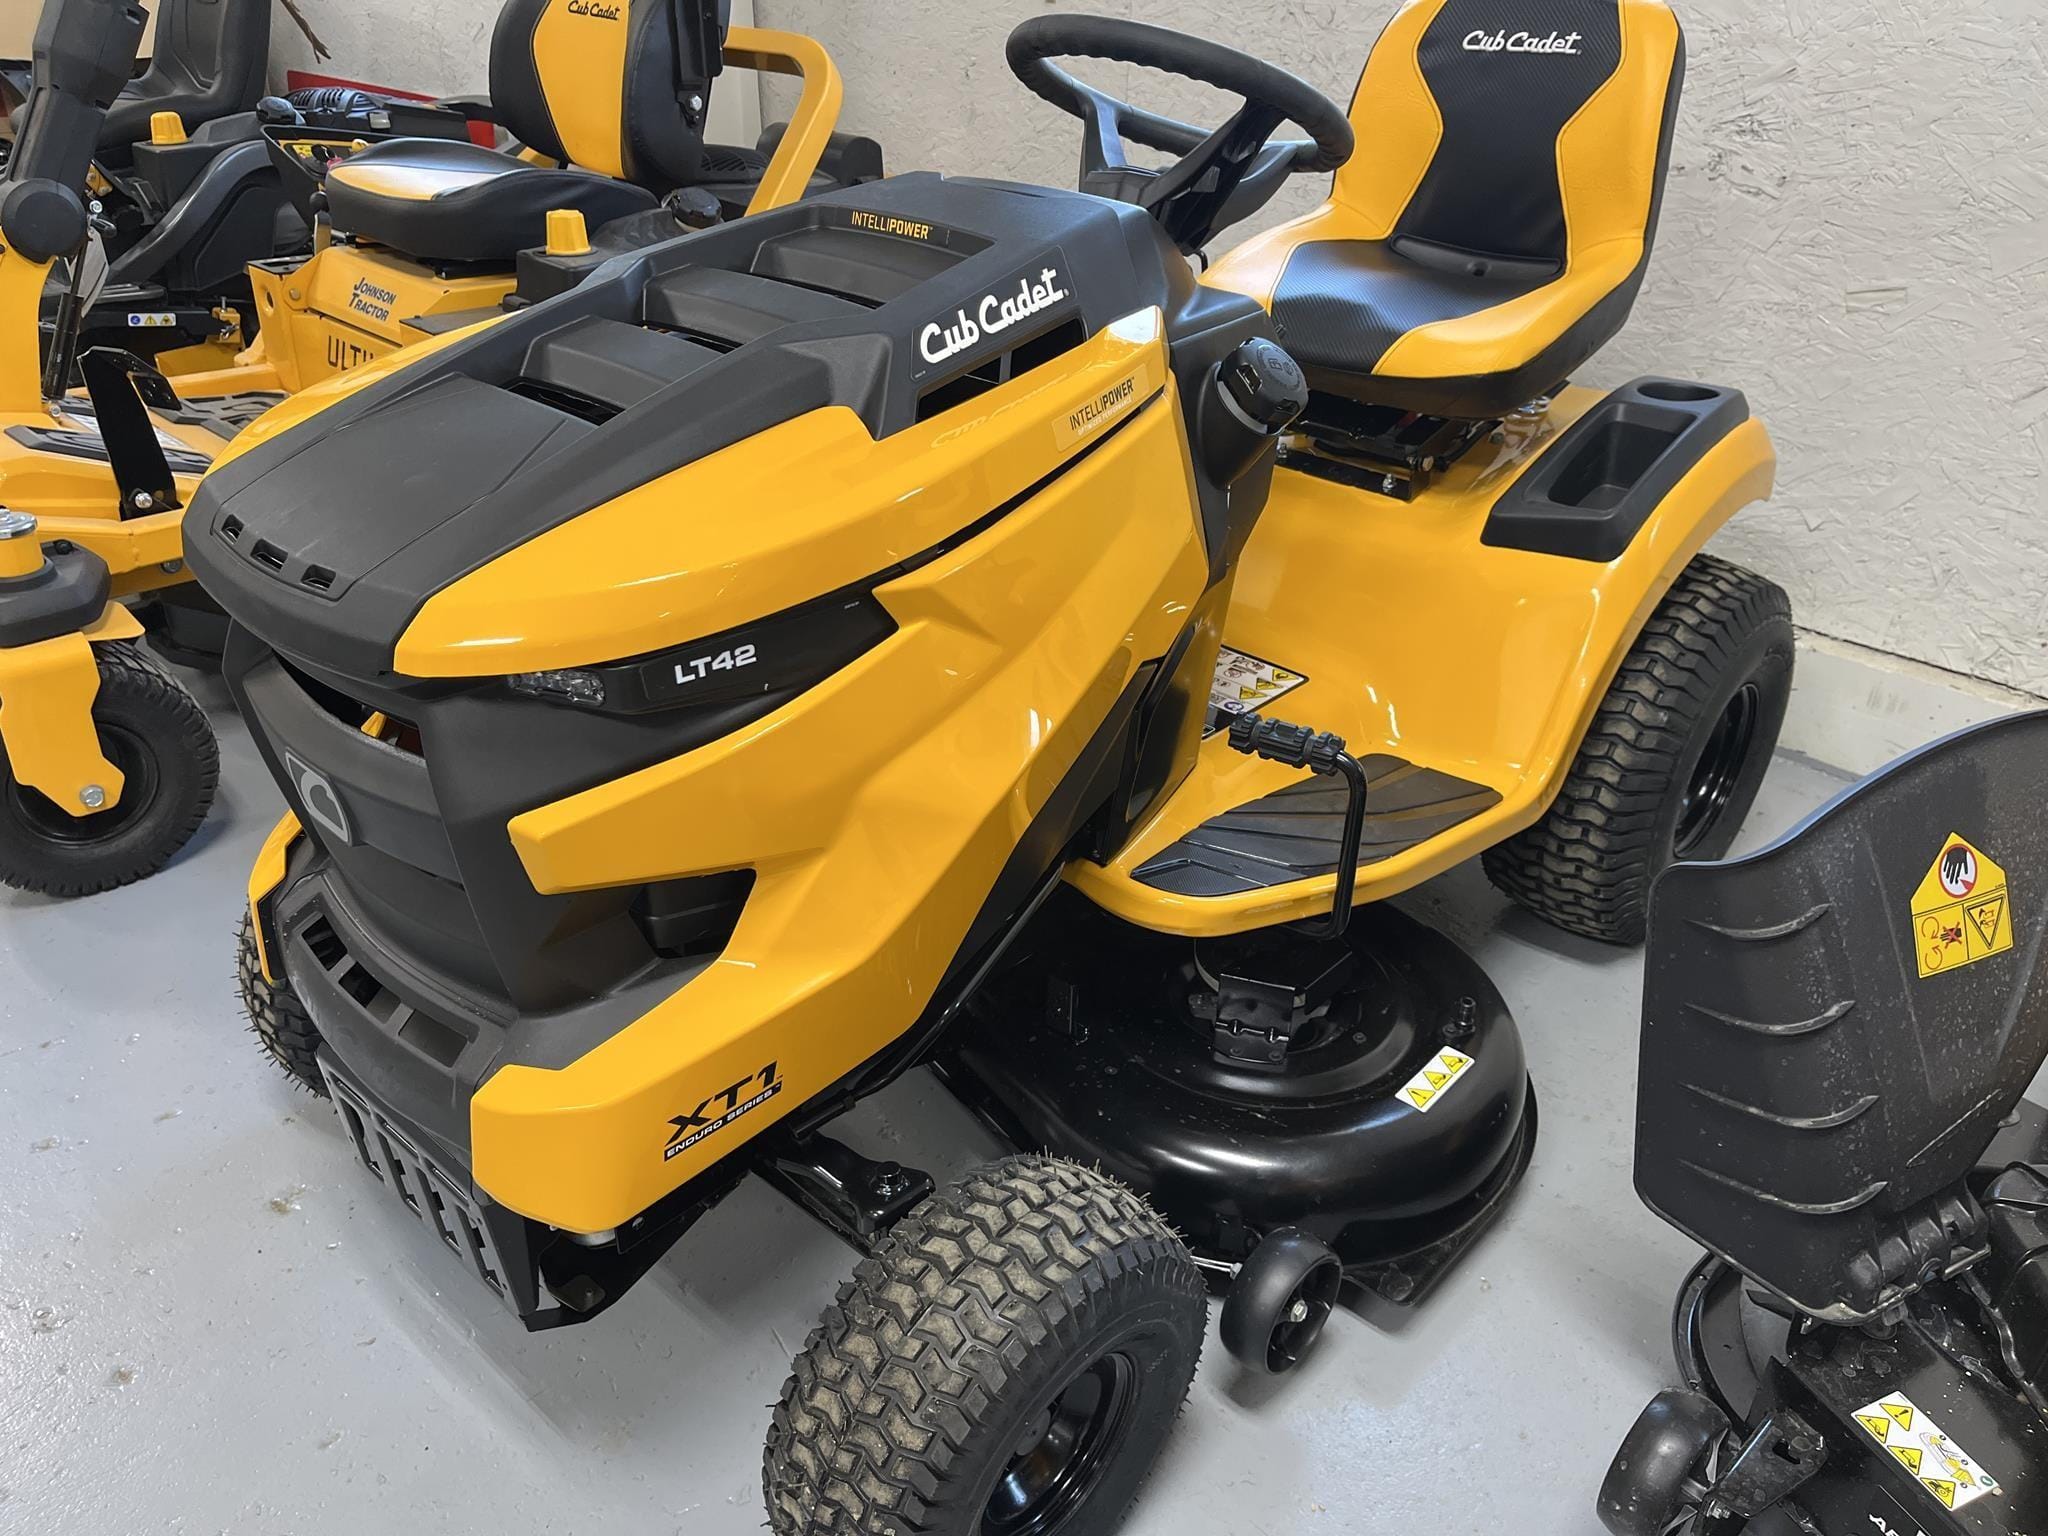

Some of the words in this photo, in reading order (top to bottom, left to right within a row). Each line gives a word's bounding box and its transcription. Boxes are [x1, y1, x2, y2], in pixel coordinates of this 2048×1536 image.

[568, 0, 589, 15] Cub
[590, 3, 620, 20] Cadet
[1462, 29, 1505, 51] Cub
[1506, 31, 1581, 54] Cadet
[852, 211, 928, 240] INTELLIPOWER
[349, 292, 389, 321] TRACTOR
[354, 277, 396, 304] JOHNSON
[920, 309, 979, 364] Cub
[979, 268, 1064, 334] Cadet
[328, 335, 373, 371] ULT
[1070, 378, 1134, 430] INTELLIPOWER
[674, 644, 757, 684] LT42
[665, 1060, 777, 1147] XT1
[666, 1119, 722, 1158] ENDURO
[727, 1088, 773, 1122] SERIES
